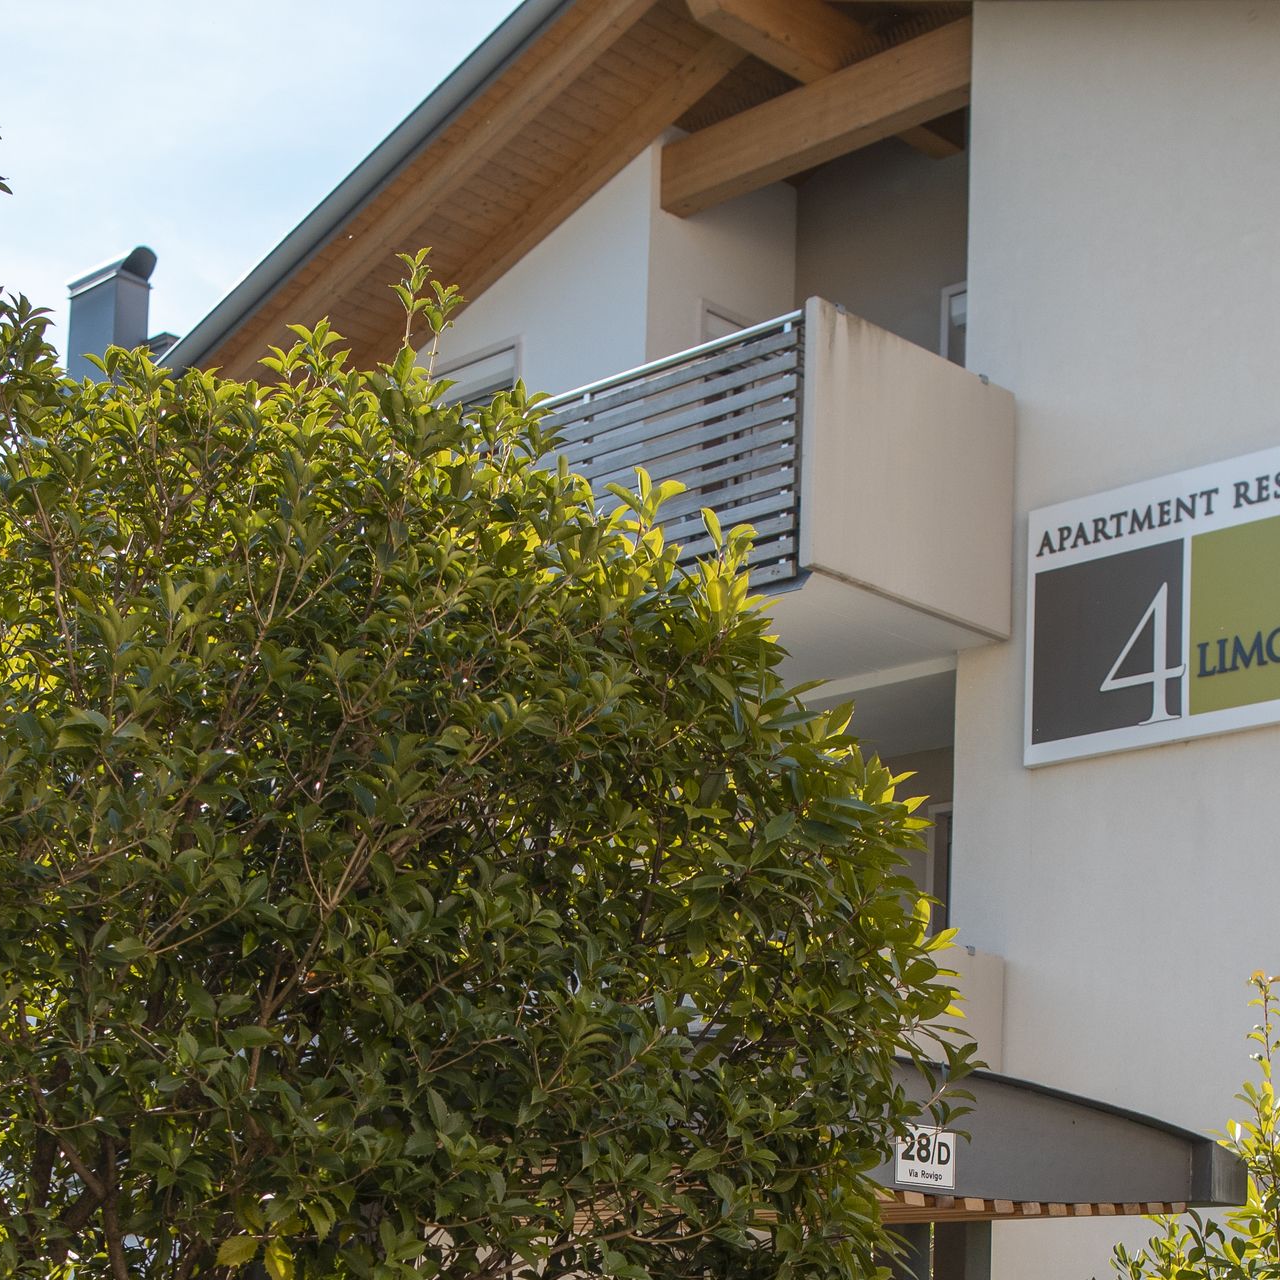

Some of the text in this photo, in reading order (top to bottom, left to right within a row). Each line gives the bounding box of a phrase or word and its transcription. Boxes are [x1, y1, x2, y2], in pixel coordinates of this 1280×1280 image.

[1035, 488, 1219, 558] APARTMENT
[1099, 581, 1186, 726] 4
[901, 1132, 951, 1165] 28/D
[909, 1169, 943, 1181] Via Rovigo
